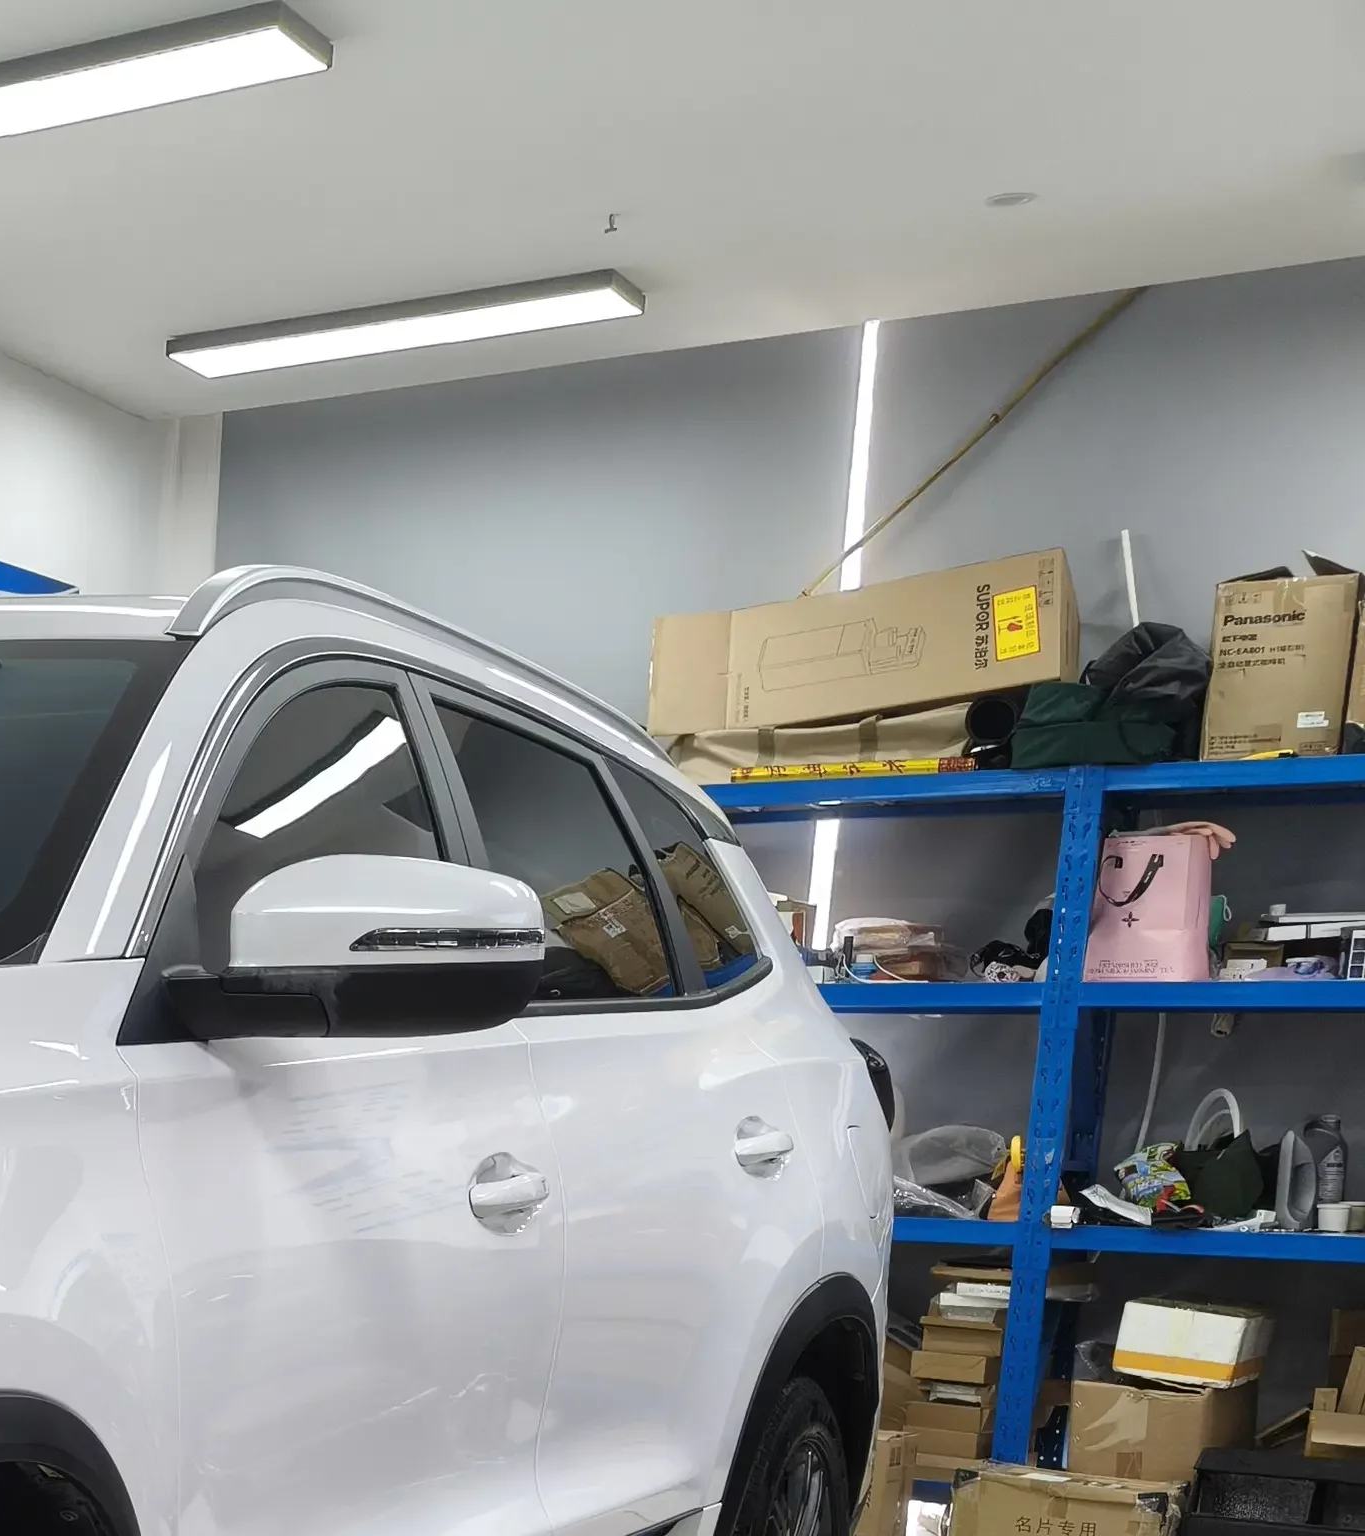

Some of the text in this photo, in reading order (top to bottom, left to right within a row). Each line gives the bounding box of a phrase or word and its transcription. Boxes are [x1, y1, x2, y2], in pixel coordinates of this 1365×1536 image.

[974, 584, 991, 670] SUPOR 苏泊尔
[1223, 610, 1306, 627] Panasonic
